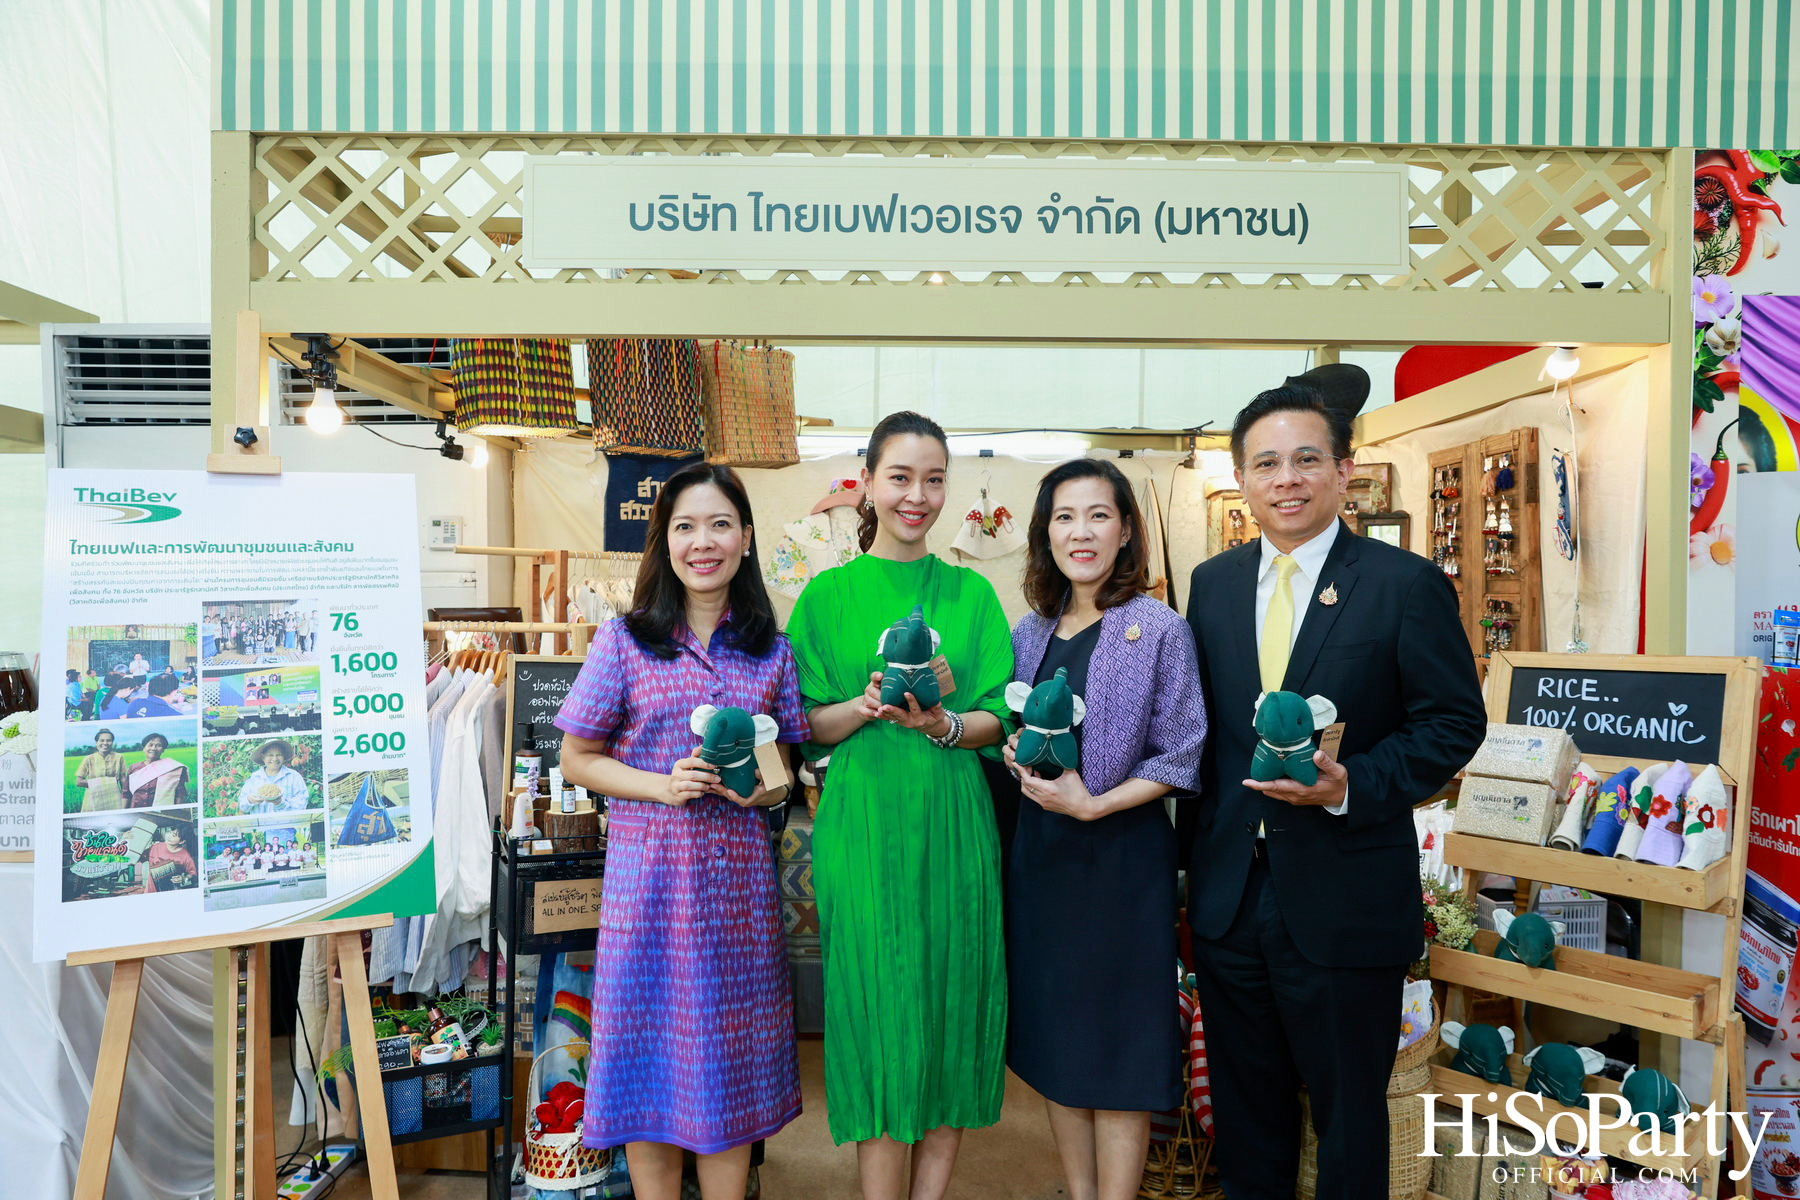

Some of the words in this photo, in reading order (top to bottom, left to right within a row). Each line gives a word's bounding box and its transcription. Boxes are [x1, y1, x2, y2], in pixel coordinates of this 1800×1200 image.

[629, 192, 737, 232] บริษัท
[747, 191, 1023, 234] ไทยเบฟเวอเรจ
[1036, 192, 1141, 235] จำกัด
[1154, 200, 1309, 244] (มหาชน)
[73, 487, 178, 503] ThaiBev
[620, 500, 653, 520] สรร
[69, 539, 355, 556] ไทยเบฟและการพัฒนาชุมชนและสังคม
[329, 612, 359, 632] 76
[1753, 621, 1773, 631] MA
[1752, 634, 1773, 643] ORIG
[330, 651, 398, 676] 1,600
[333, 692, 404, 718] 5,000
[1522, 705, 1577, 728] 100%
[1583, 711, 1706, 744] ORGANIC
[334, 731, 406, 758] 2,600
[542, 908, 555, 917] ALL
[557, 907, 566, 916] IN
[568, 904, 589, 914] ONE
